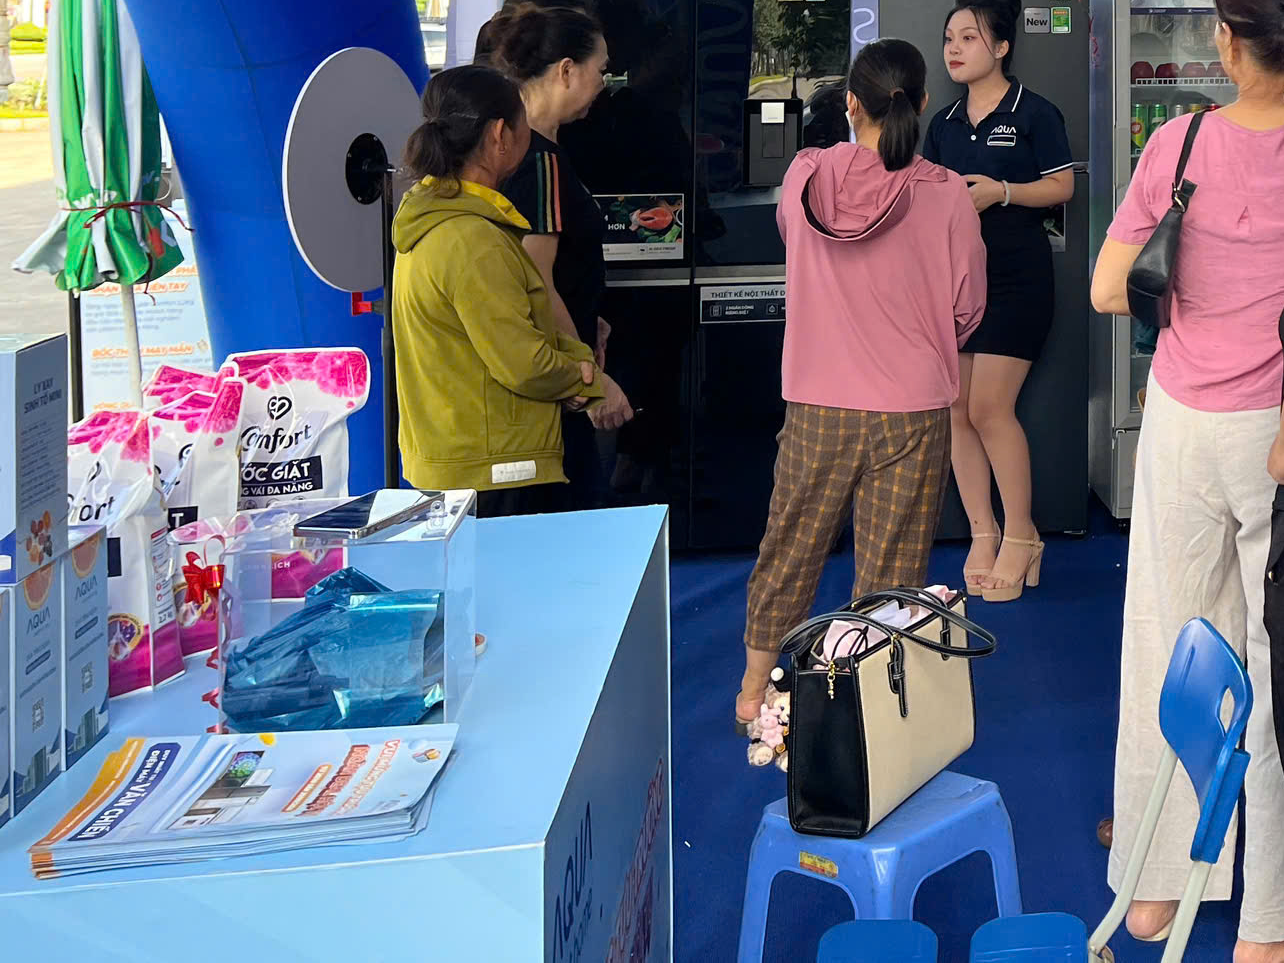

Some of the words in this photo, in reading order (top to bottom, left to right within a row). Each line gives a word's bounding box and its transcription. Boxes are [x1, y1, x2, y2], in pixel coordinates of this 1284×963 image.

[1026, 18, 1048, 26] New
[990, 125, 1017, 134] AQUA
[271, 459, 311, 483] GIẶT
[282, 480, 314, 494] NĂNG
[75, 576, 98, 600] AQUA
[26, 606, 51, 635] AQUA
